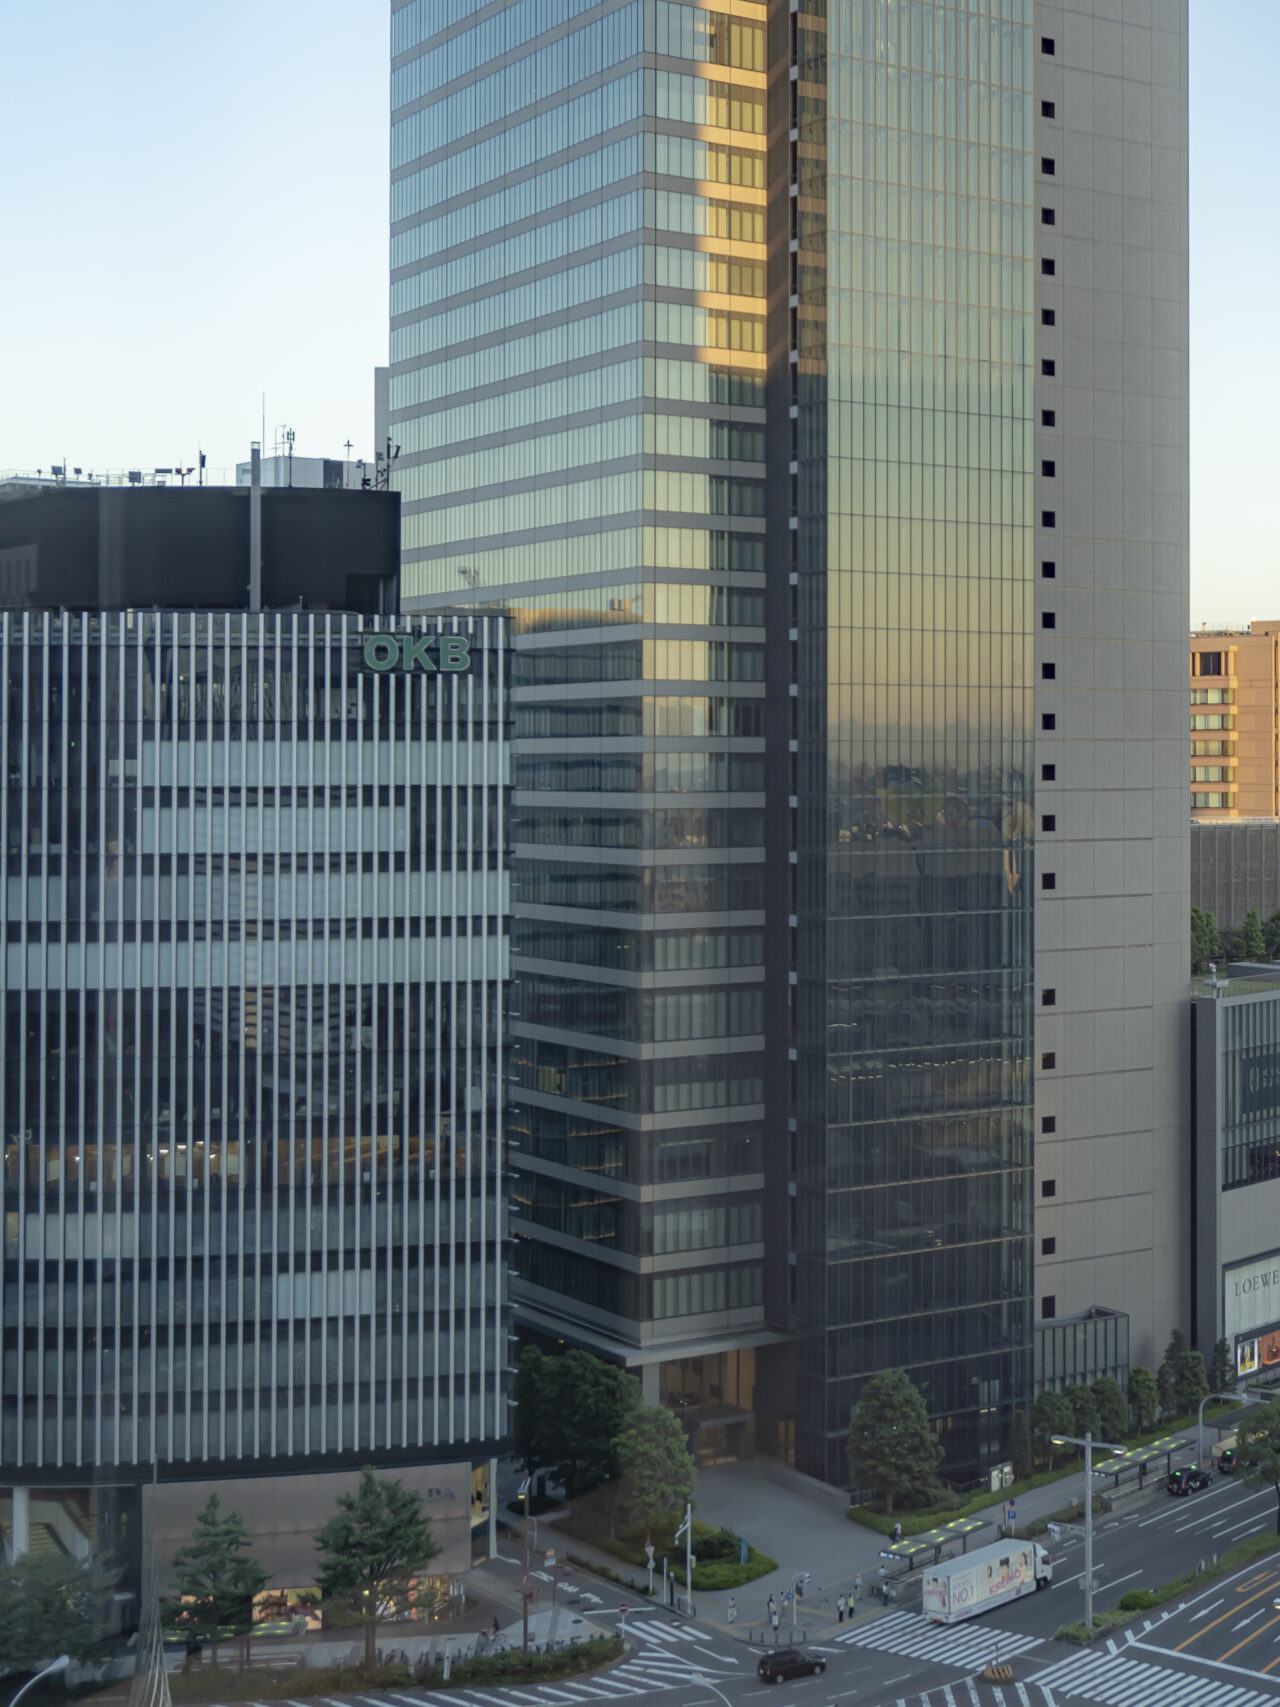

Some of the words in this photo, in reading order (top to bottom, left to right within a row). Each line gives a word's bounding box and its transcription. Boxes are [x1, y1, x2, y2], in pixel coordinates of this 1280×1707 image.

[364, 635, 471, 671] OKB
[1234, 1269, 1280, 1297] LOEWE
[952, 1585, 974, 1605] NO.1
